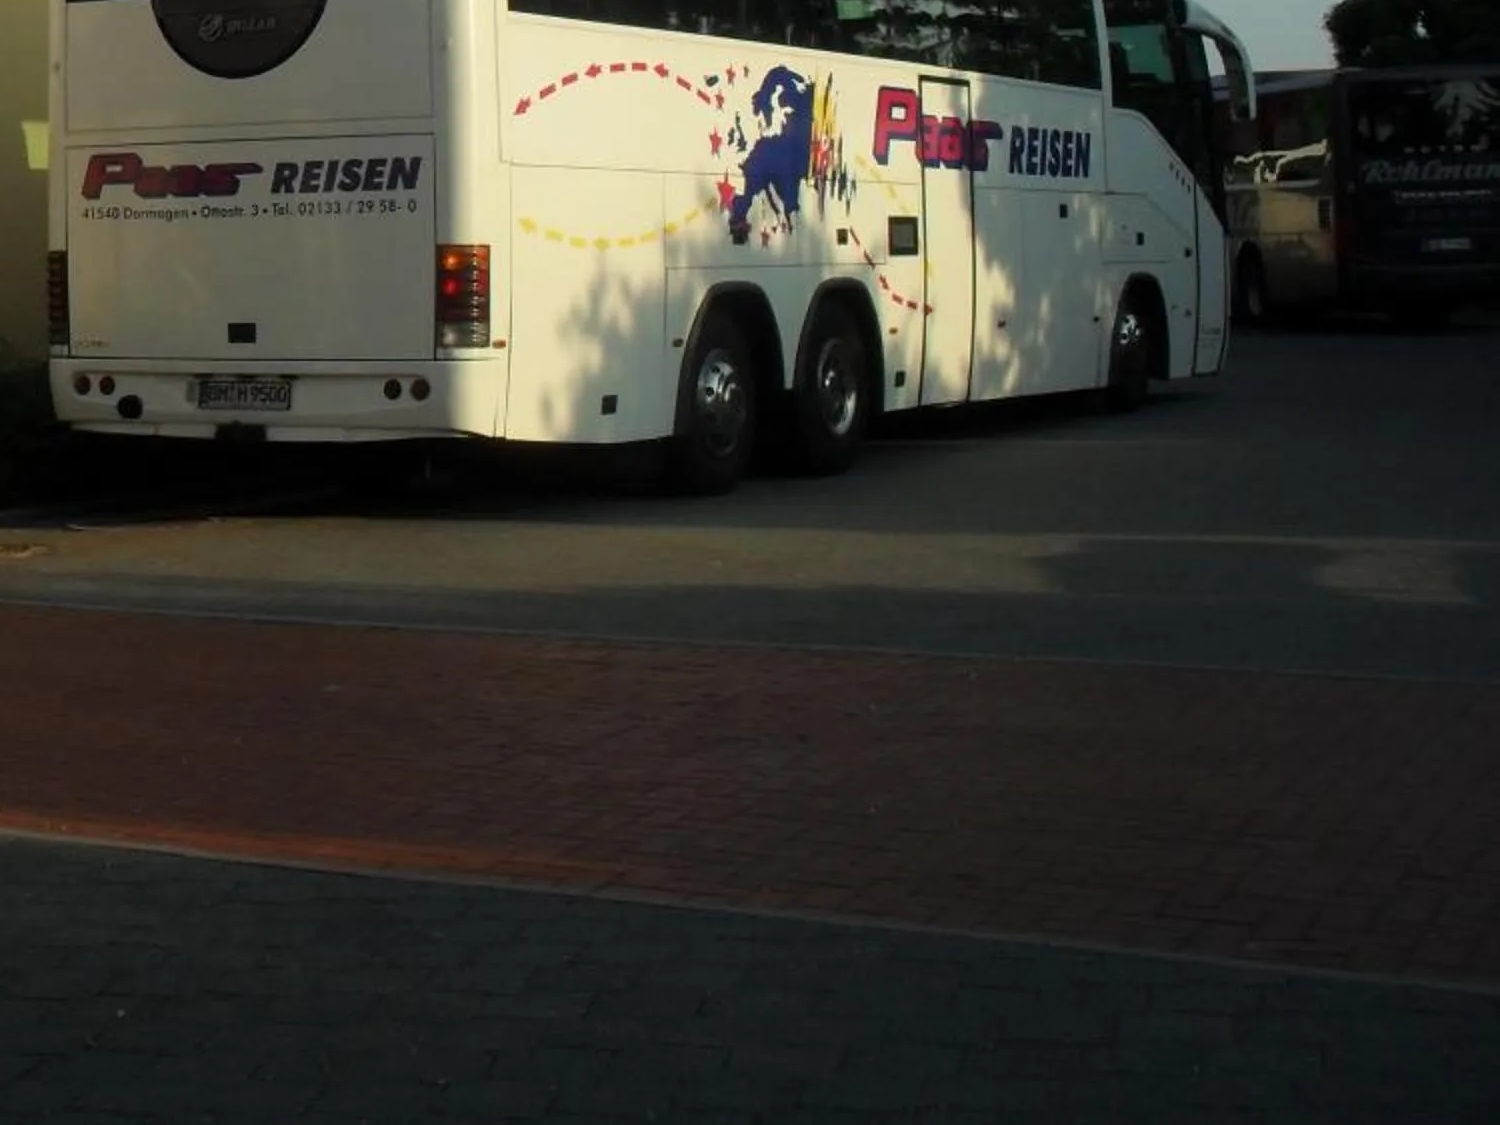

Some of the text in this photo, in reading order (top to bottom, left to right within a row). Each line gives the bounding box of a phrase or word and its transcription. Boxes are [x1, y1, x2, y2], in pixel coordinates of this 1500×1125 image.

[1009, 125, 1091, 179] REISEN
[270, 156, 422, 194] REISEN
[123, 206, 189, 222] Dormagen
[297, 200, 341, 216] 02133
